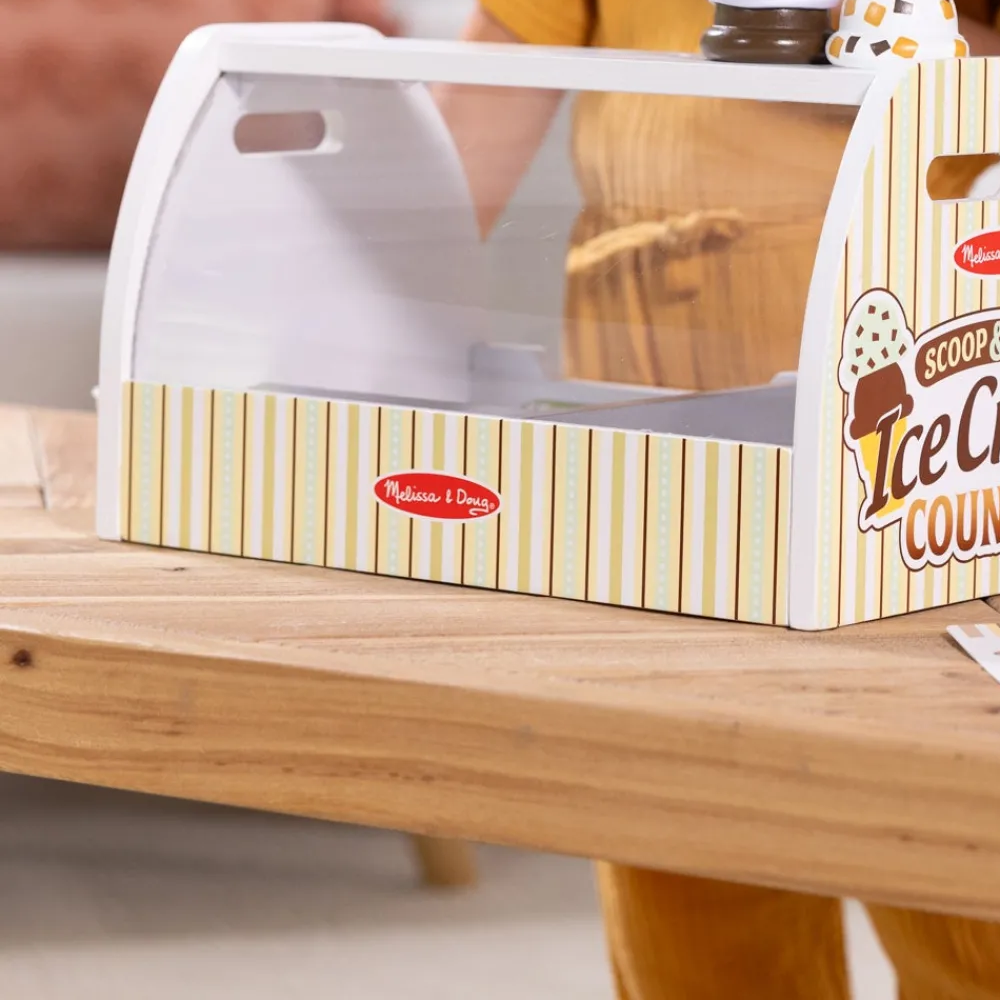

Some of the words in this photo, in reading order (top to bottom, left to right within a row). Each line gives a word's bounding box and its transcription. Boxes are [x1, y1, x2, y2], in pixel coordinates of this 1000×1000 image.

[924, 327, 988, 380] SCOOP
[865, 408, 951, 521] Ice
[384, 479, 441, 505] Melissa
